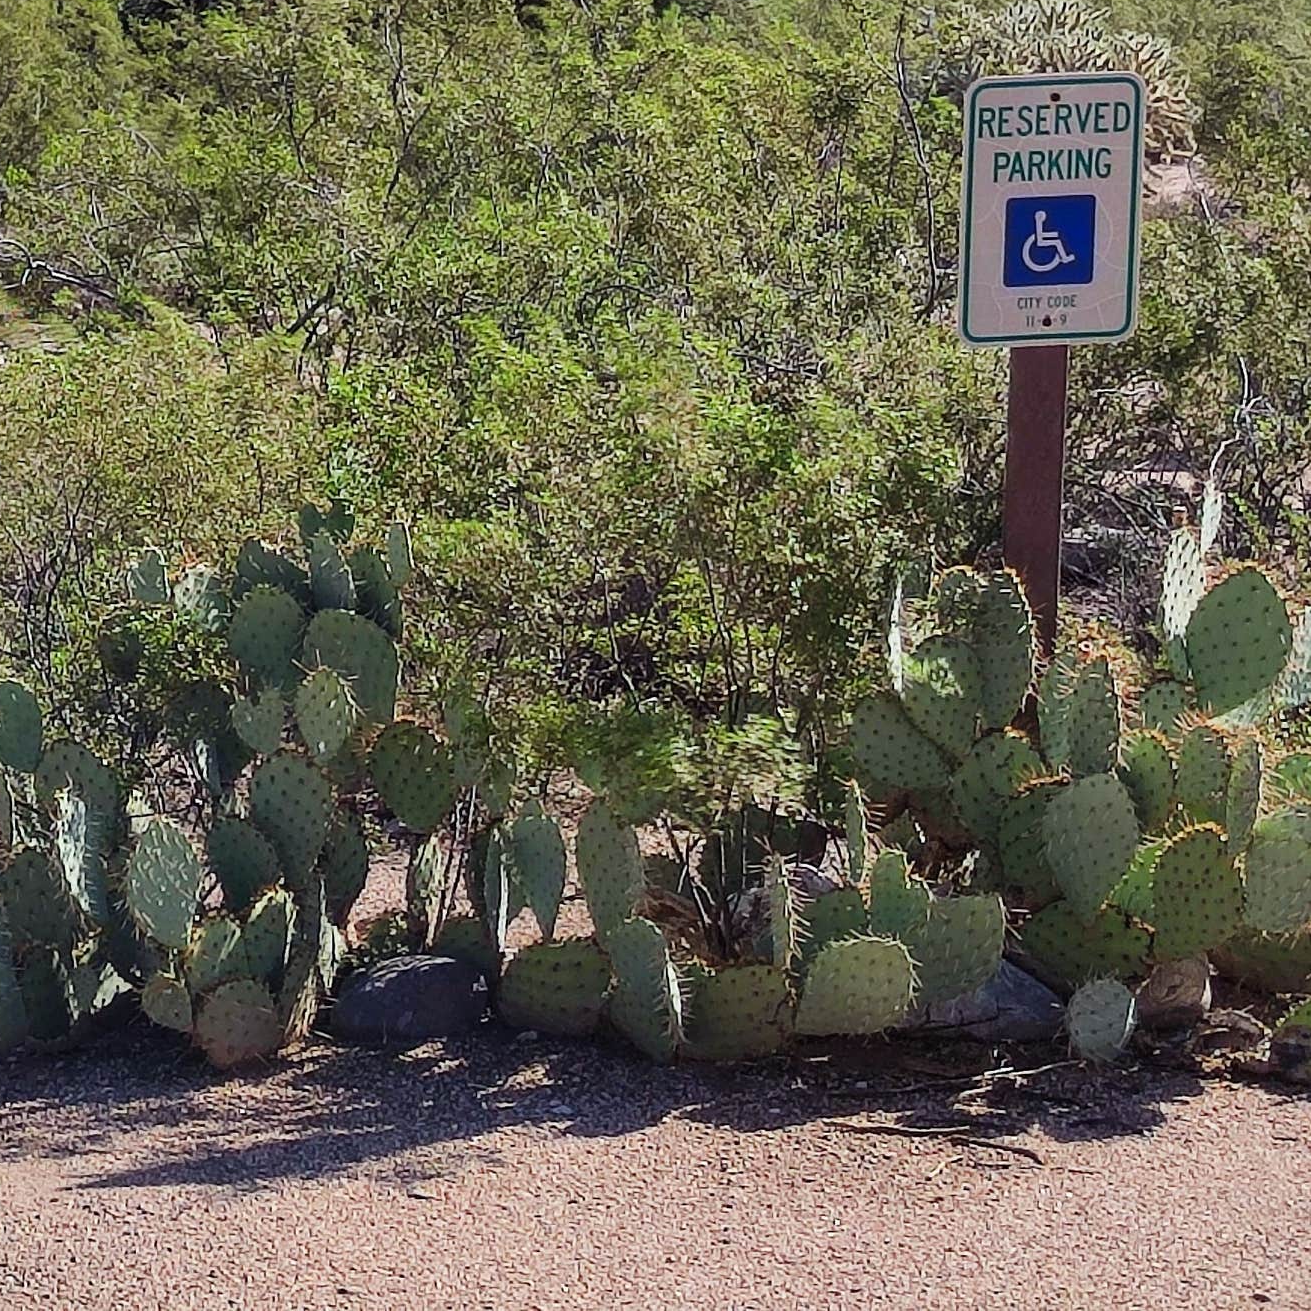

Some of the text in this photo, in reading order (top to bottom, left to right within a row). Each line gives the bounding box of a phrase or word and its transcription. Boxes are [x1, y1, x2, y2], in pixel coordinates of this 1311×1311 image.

[978, 102, 1131, 138] RESERVED
[993, 147, 1112, 183] PARKING
[1017, 294, 1077, 310] CITY CODE
[1025, 314, 1067, 327] 11--9
